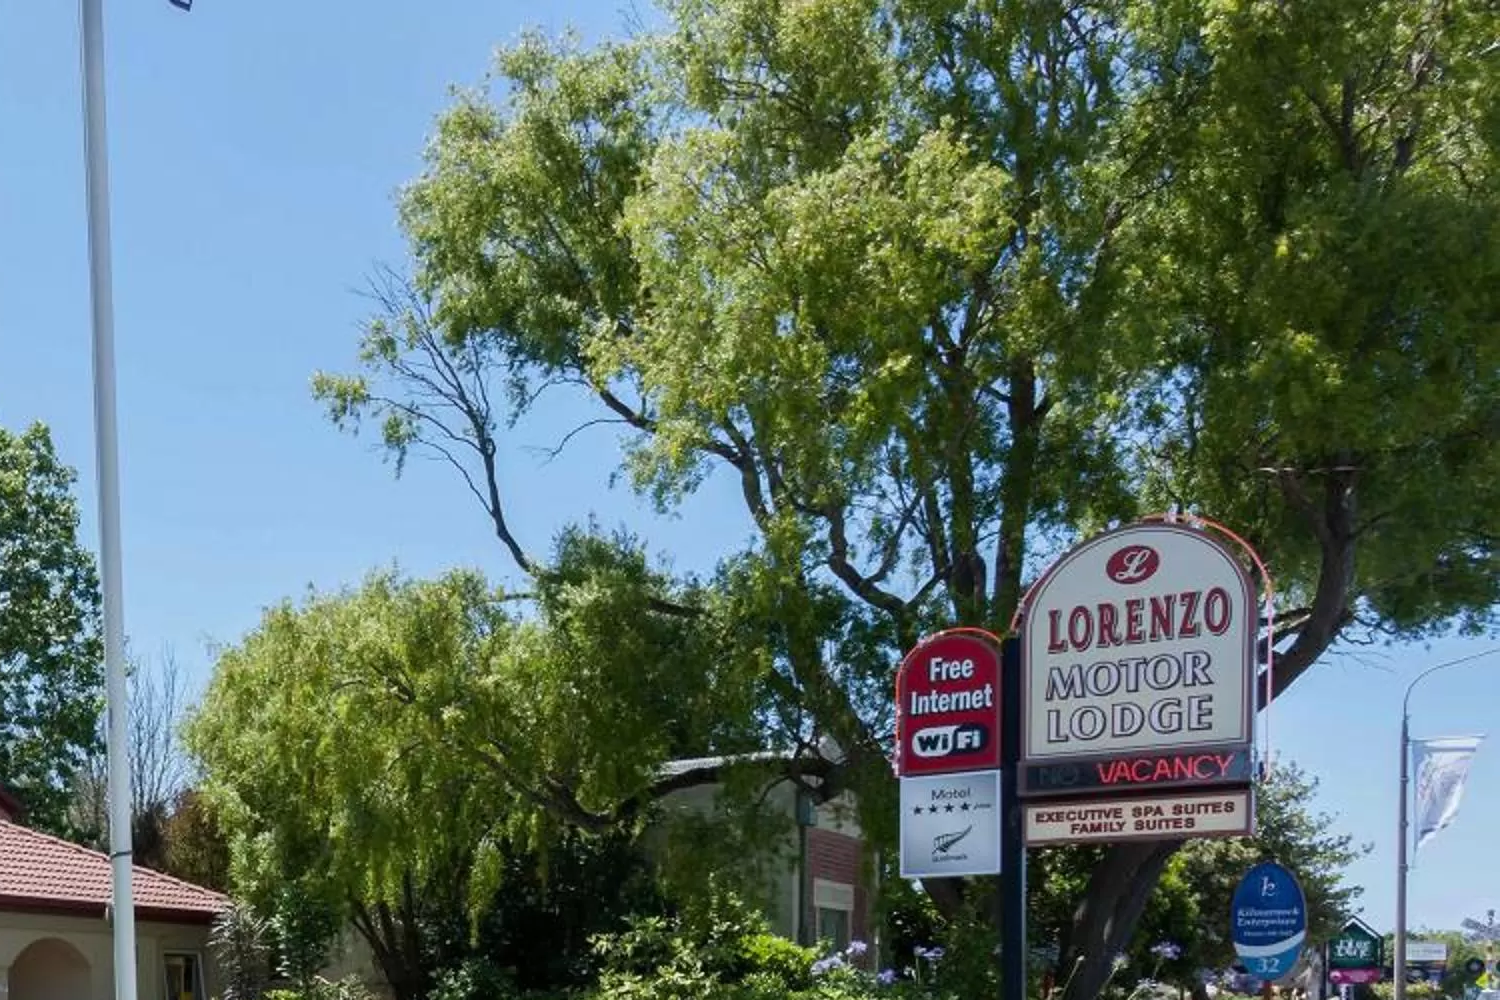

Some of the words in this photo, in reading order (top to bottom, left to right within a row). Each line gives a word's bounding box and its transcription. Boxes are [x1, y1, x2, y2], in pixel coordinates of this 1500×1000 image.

[1047, 586, 1233, 655] LORENZO
[930, 657, 974, 682] Free
[1045, 650, 1214, 701] MOTOR
[910, 683, 993, 715] Internet
[1046, 694, 1214, 743] LODGE
[1096, 753, 1237, 784] VACANCY
[931, 787, 971, 801] Motel
[1035, 807, 1124, 823] EXECUTIVE
[1132, 804, 1164, 819] SPA
[1172, 801, 1236, 816] SUITES
[1070, 821, 1127, 835] FAMILY
[1134, 817, 1196, 831] SUITES
[1256, 957, 1280, 973] 32
